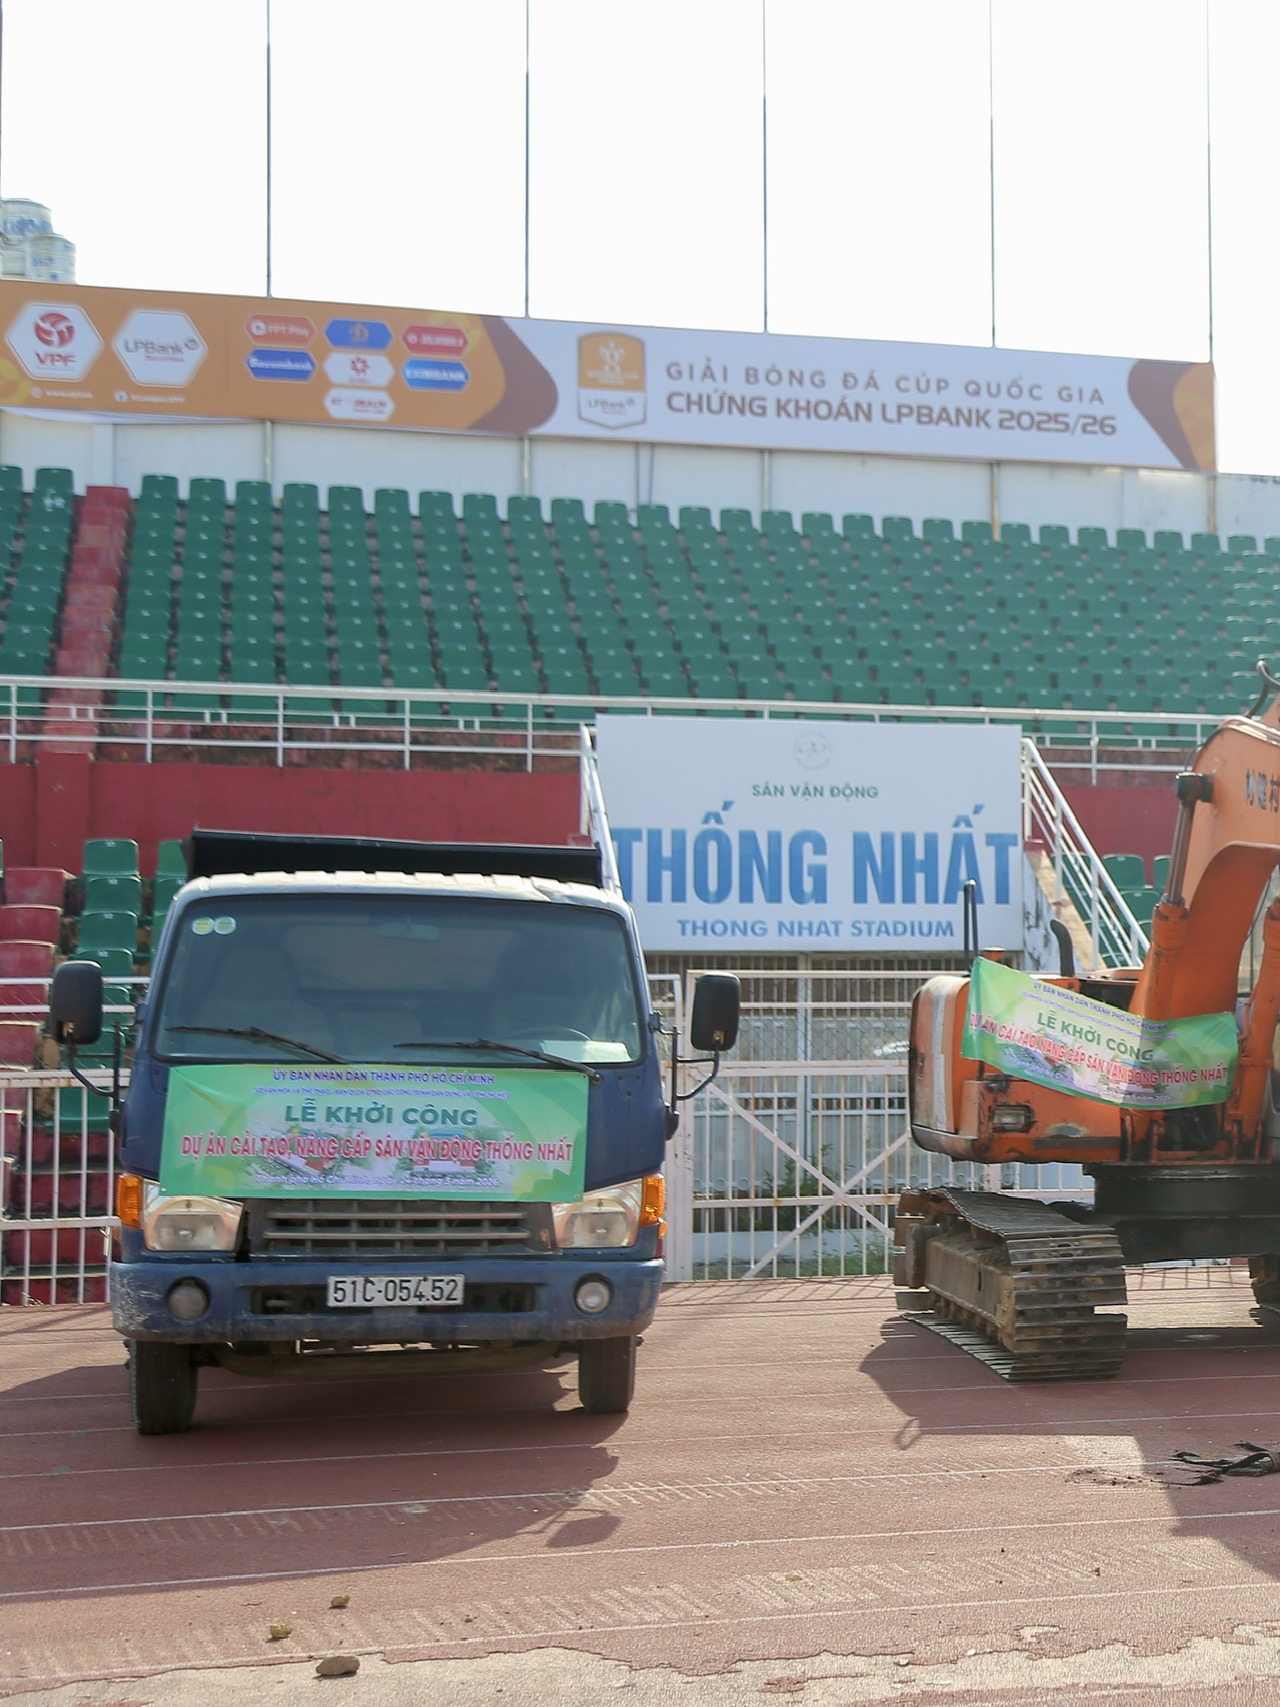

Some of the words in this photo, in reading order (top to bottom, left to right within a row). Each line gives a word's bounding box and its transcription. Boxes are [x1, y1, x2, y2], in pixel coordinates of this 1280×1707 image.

[35, 351, 76, 366] VPF
[124, 339, 184, 356] LPBank
[665, 356, 728, 383] GIẢI
[745, 364, 826, 389] BÓNG
[842, 369, 880, 391] ĐÁ
[895, 371, 950, 395] CÚP
[964, 374, 1043, 400] QUỐC
[1057, 384, 1105, 405] GIA
[666, 388, 768, 418] CHỨNG
[776, 395, 873, 422] KHOÁN
[881, 403, 992, 429] LPBANK
[998, 409, 1118, 436] 2025/26
[752, 781, 784, 798] SÂN
[790, 781, 825, 801] VẬN
[829, 783, 879, 801] ĐỘNG
[612, 801, 828, 906] THỐNG
[853, 803, 1018, 906] NHẤT
[677, 918, 769, 937] THONG
[778, 919, 843, 937] NHAT
[851, 919, 955, 937] STADIUM
[982, 1016, 997, 1034] ÁN
[998, 1023, 1016, 1042] CẢI
[1067, 1045, 1086, 1065] CẤP
[1087, 1053, 1104, 1073] SÂN
[1107, 1058, 1125, 1081] VẬN
[1128, 1065, 1158, 1086] ĐỘNG
[1161, 1065, 1198, 1084] THỐNG
[1200, 1062, 1228, 1081] NHẤT
[1037, 1010, 1057, 1030] LỄ
[1061, 1021, 1101, 1046] KHỞI
[1106, 1038, 1153, 1062] CÔNG
[286, 1098, 317, 1122] LỄ
[326, 1101, 394, 1124] KHỞI
[403, 1104, 478, 1125] CÔNG
[182, 1132, 204, 1160] DỰ
[205, 1131, 226, 1155] ÁN
[230, 1130, 256, 1155] CẢI
[261, 1136, 293, 1162] TẠO,
[297, 1133, 338, 1157] NÂNG
[342, 1131, 371, 1158] CẤP
[376, 1135, 403, 1158] SÂN
[407, 1135, 437, 1164] VẬN
[440, 1135, 482, 1164] ĐỘNG
[486, 1135, 534, 1160] THỐNG
[537, 1136, 573, 1161] NHẤT
[334, 1278, 458, 1303] 51C-054.52
